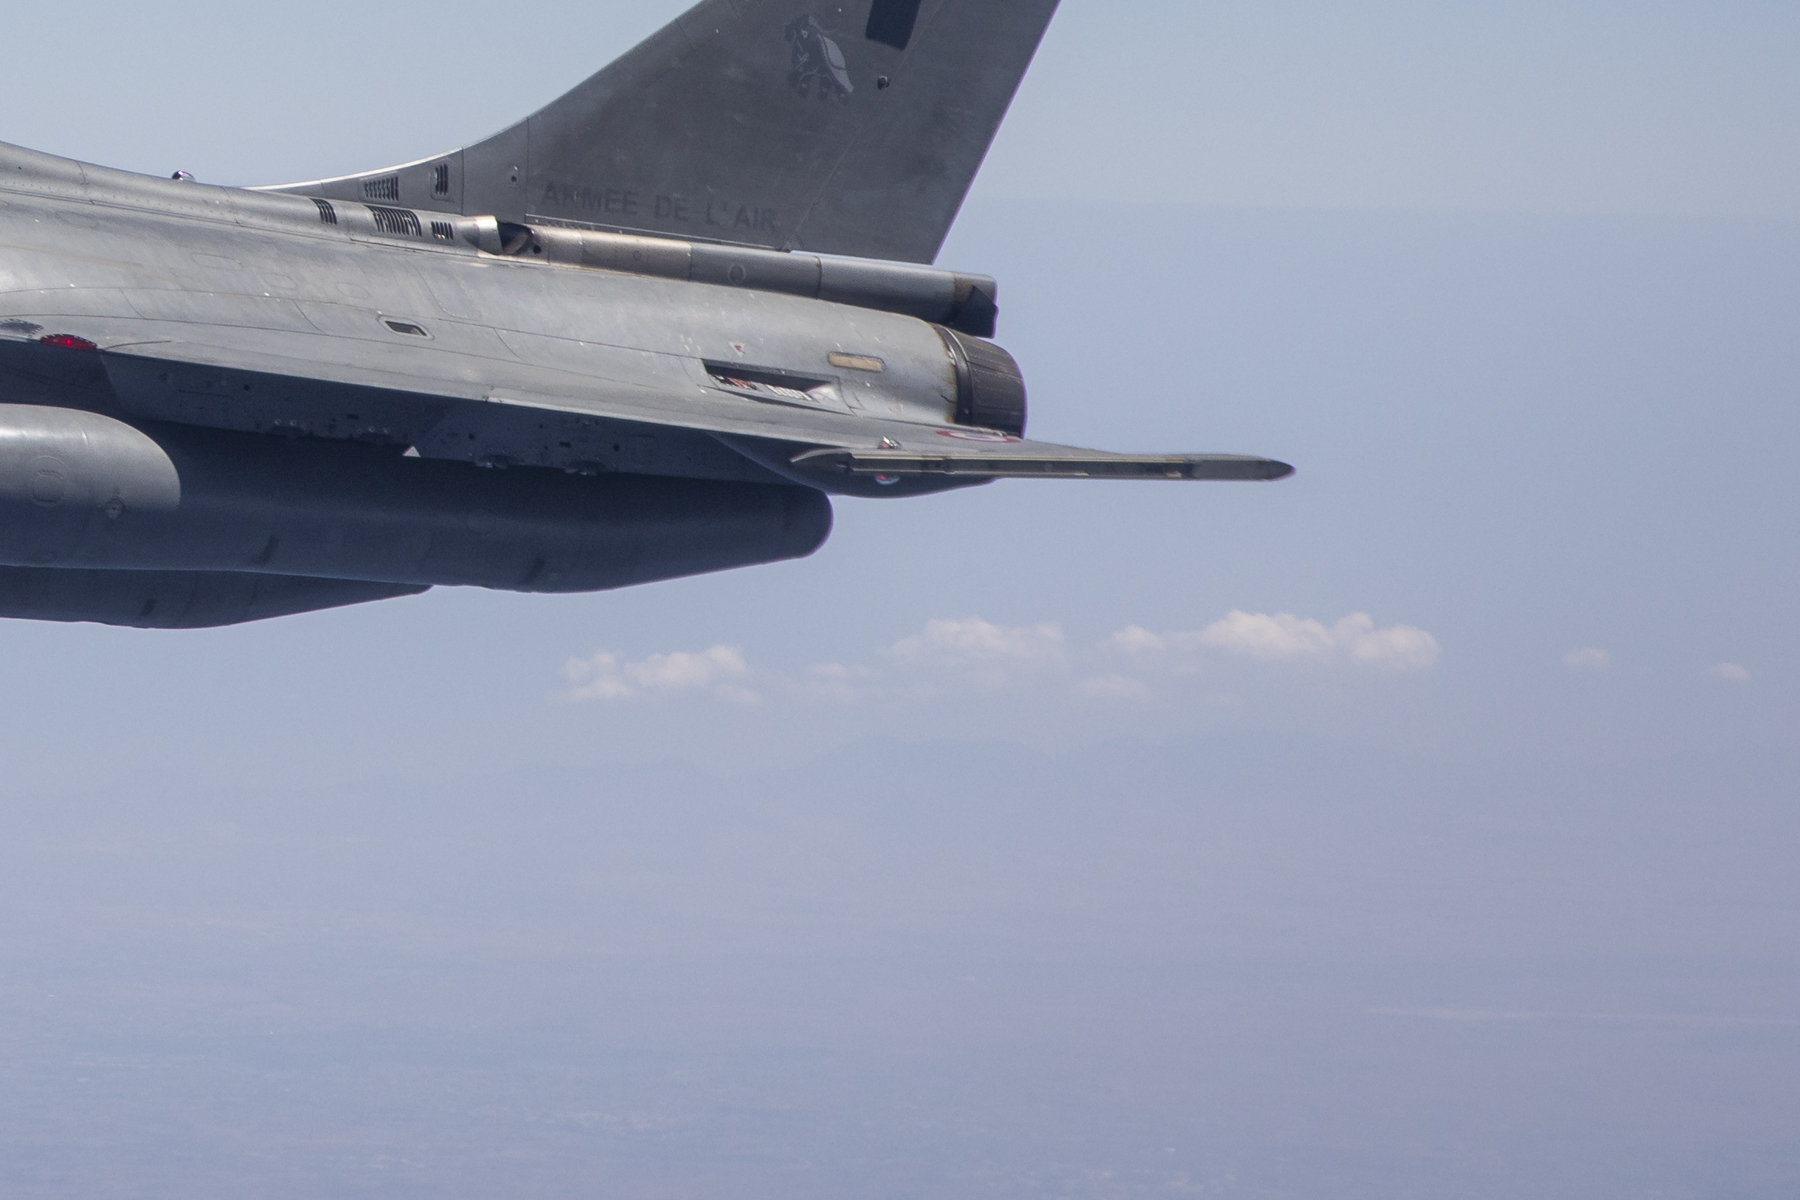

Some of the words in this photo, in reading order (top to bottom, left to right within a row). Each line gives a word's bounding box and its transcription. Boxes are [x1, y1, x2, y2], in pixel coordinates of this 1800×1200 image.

[540, 180, 640, 216] ARMEE
[654, 194, 690, 222] DE
[704, 202, 779, 233] L'AIR
